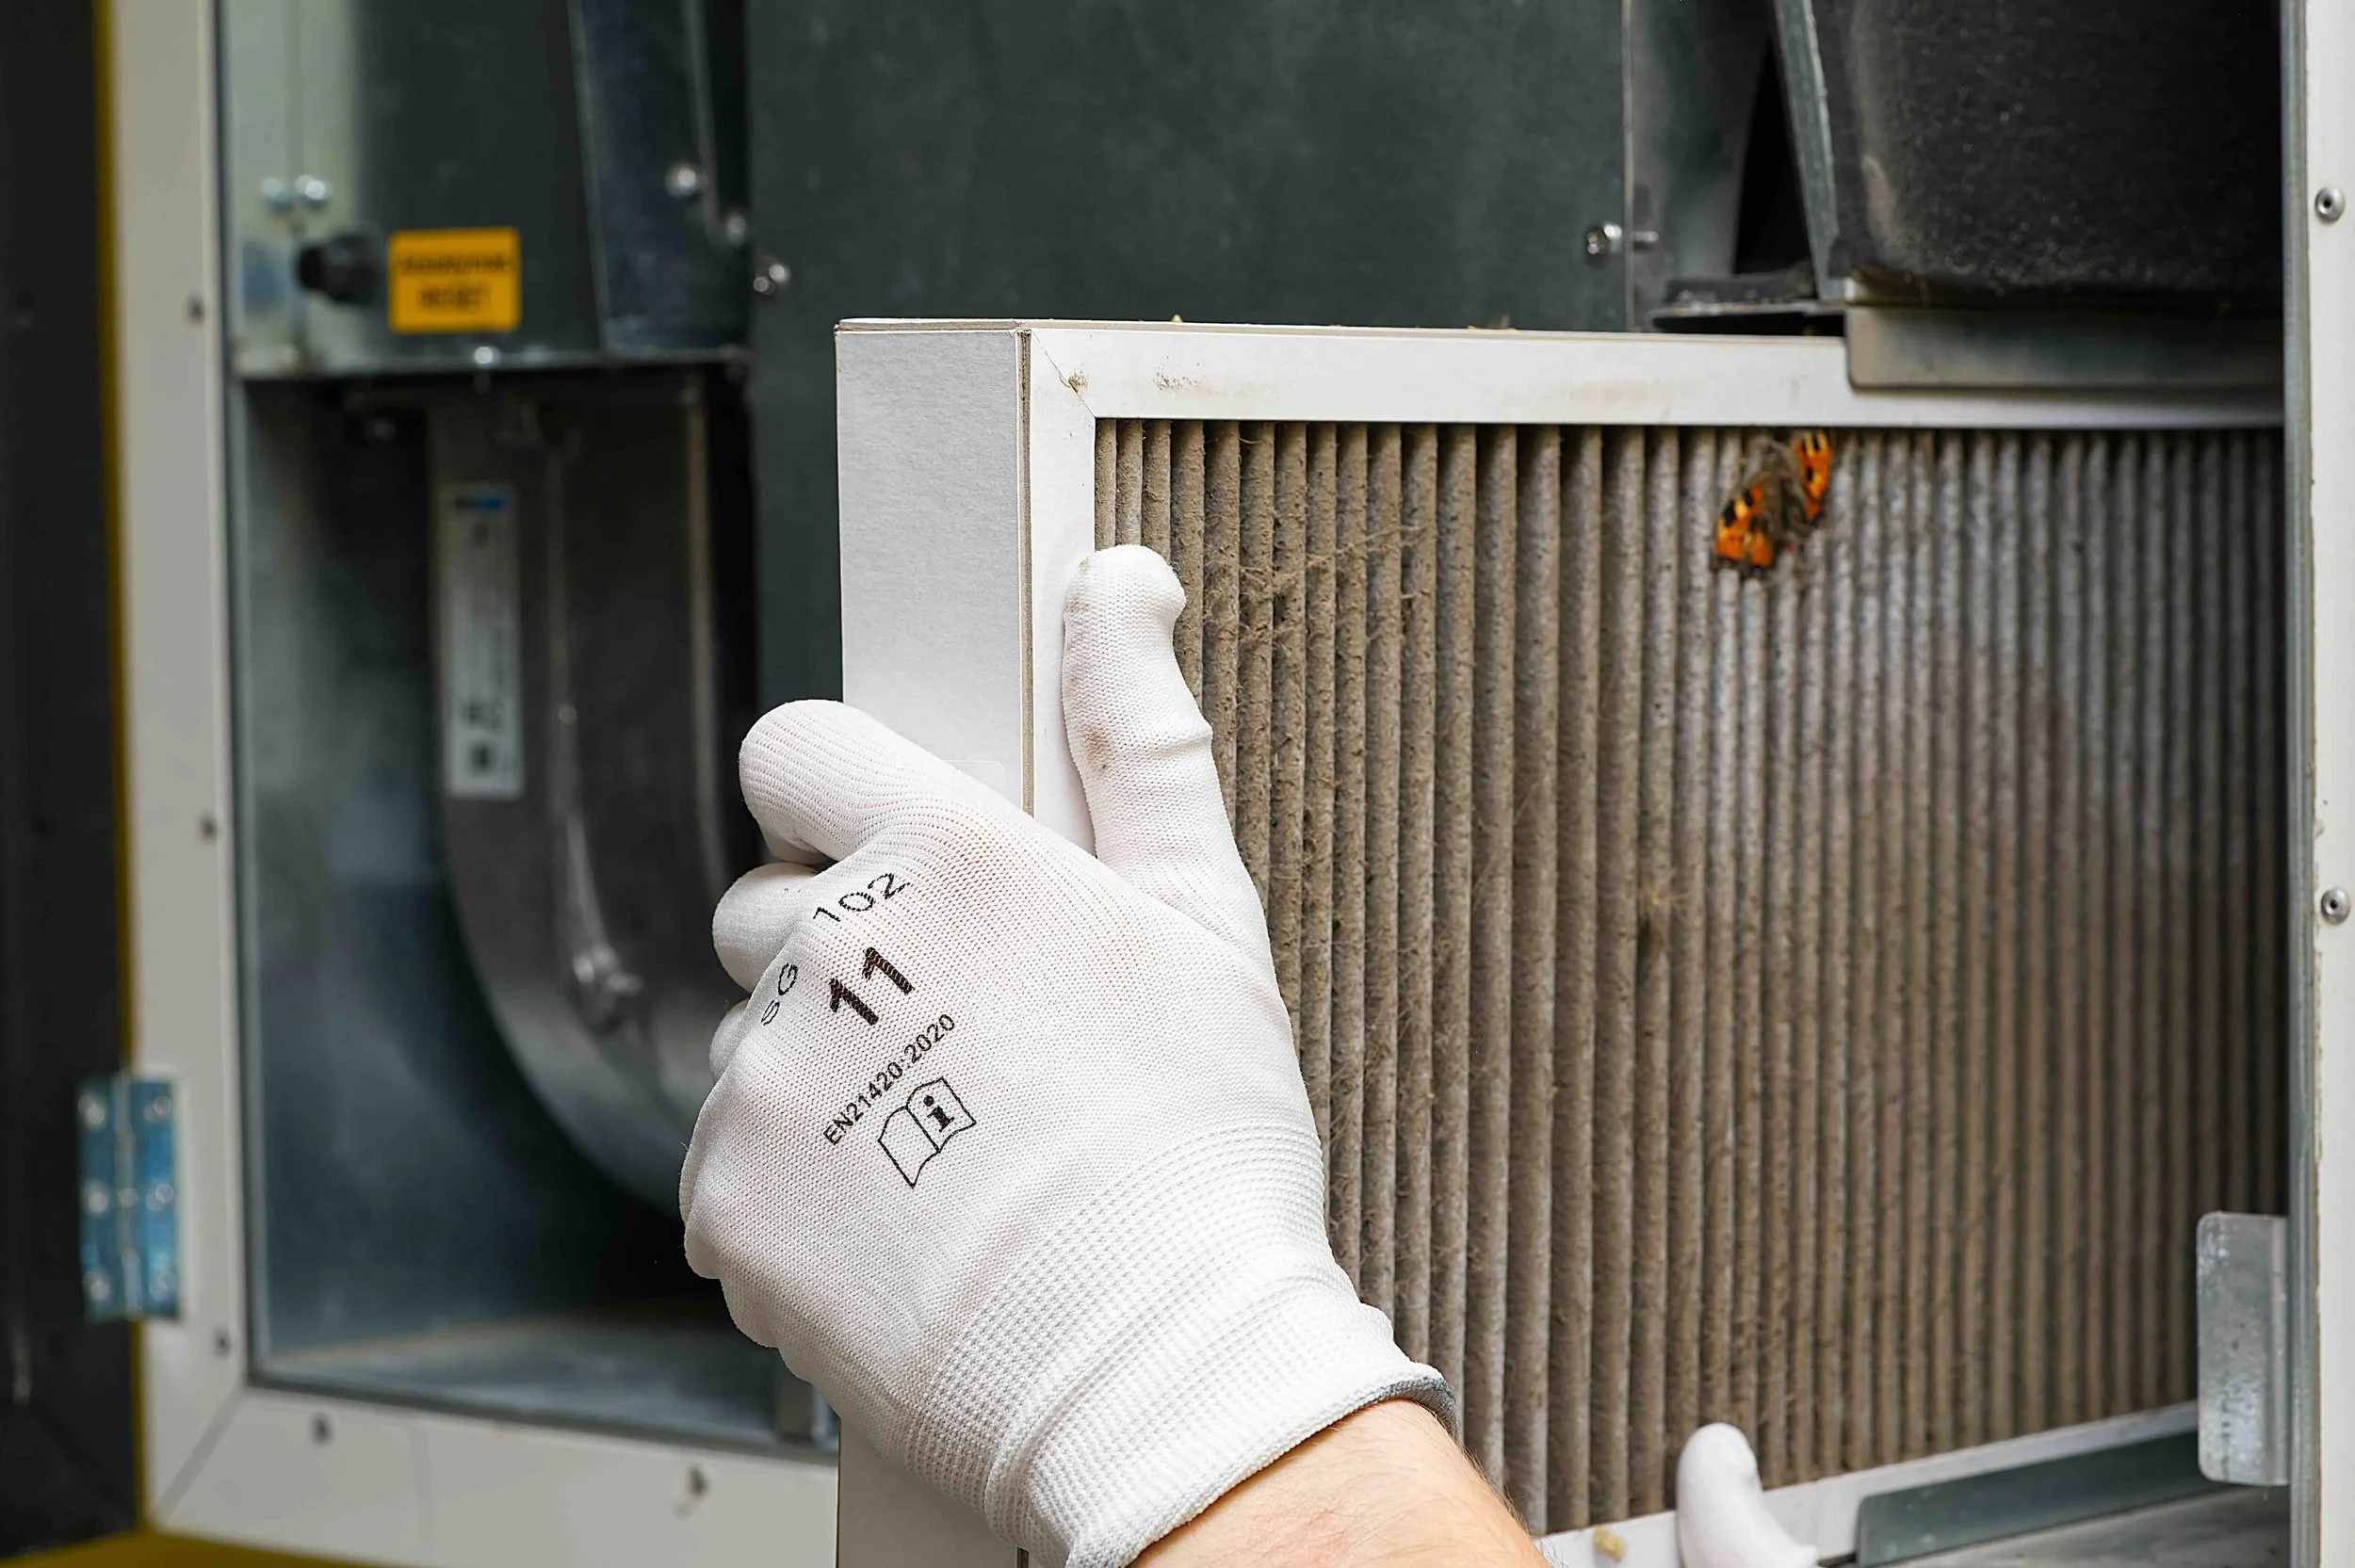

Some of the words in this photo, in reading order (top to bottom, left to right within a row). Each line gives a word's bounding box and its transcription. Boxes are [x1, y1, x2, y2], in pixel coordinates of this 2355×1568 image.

[760, 962, 799, 1026] SG
[812, 872, 912, 923] 102
[827, 946, 917, 1026] 11
[822, 1013, 956, 1146] EN21420:2020
